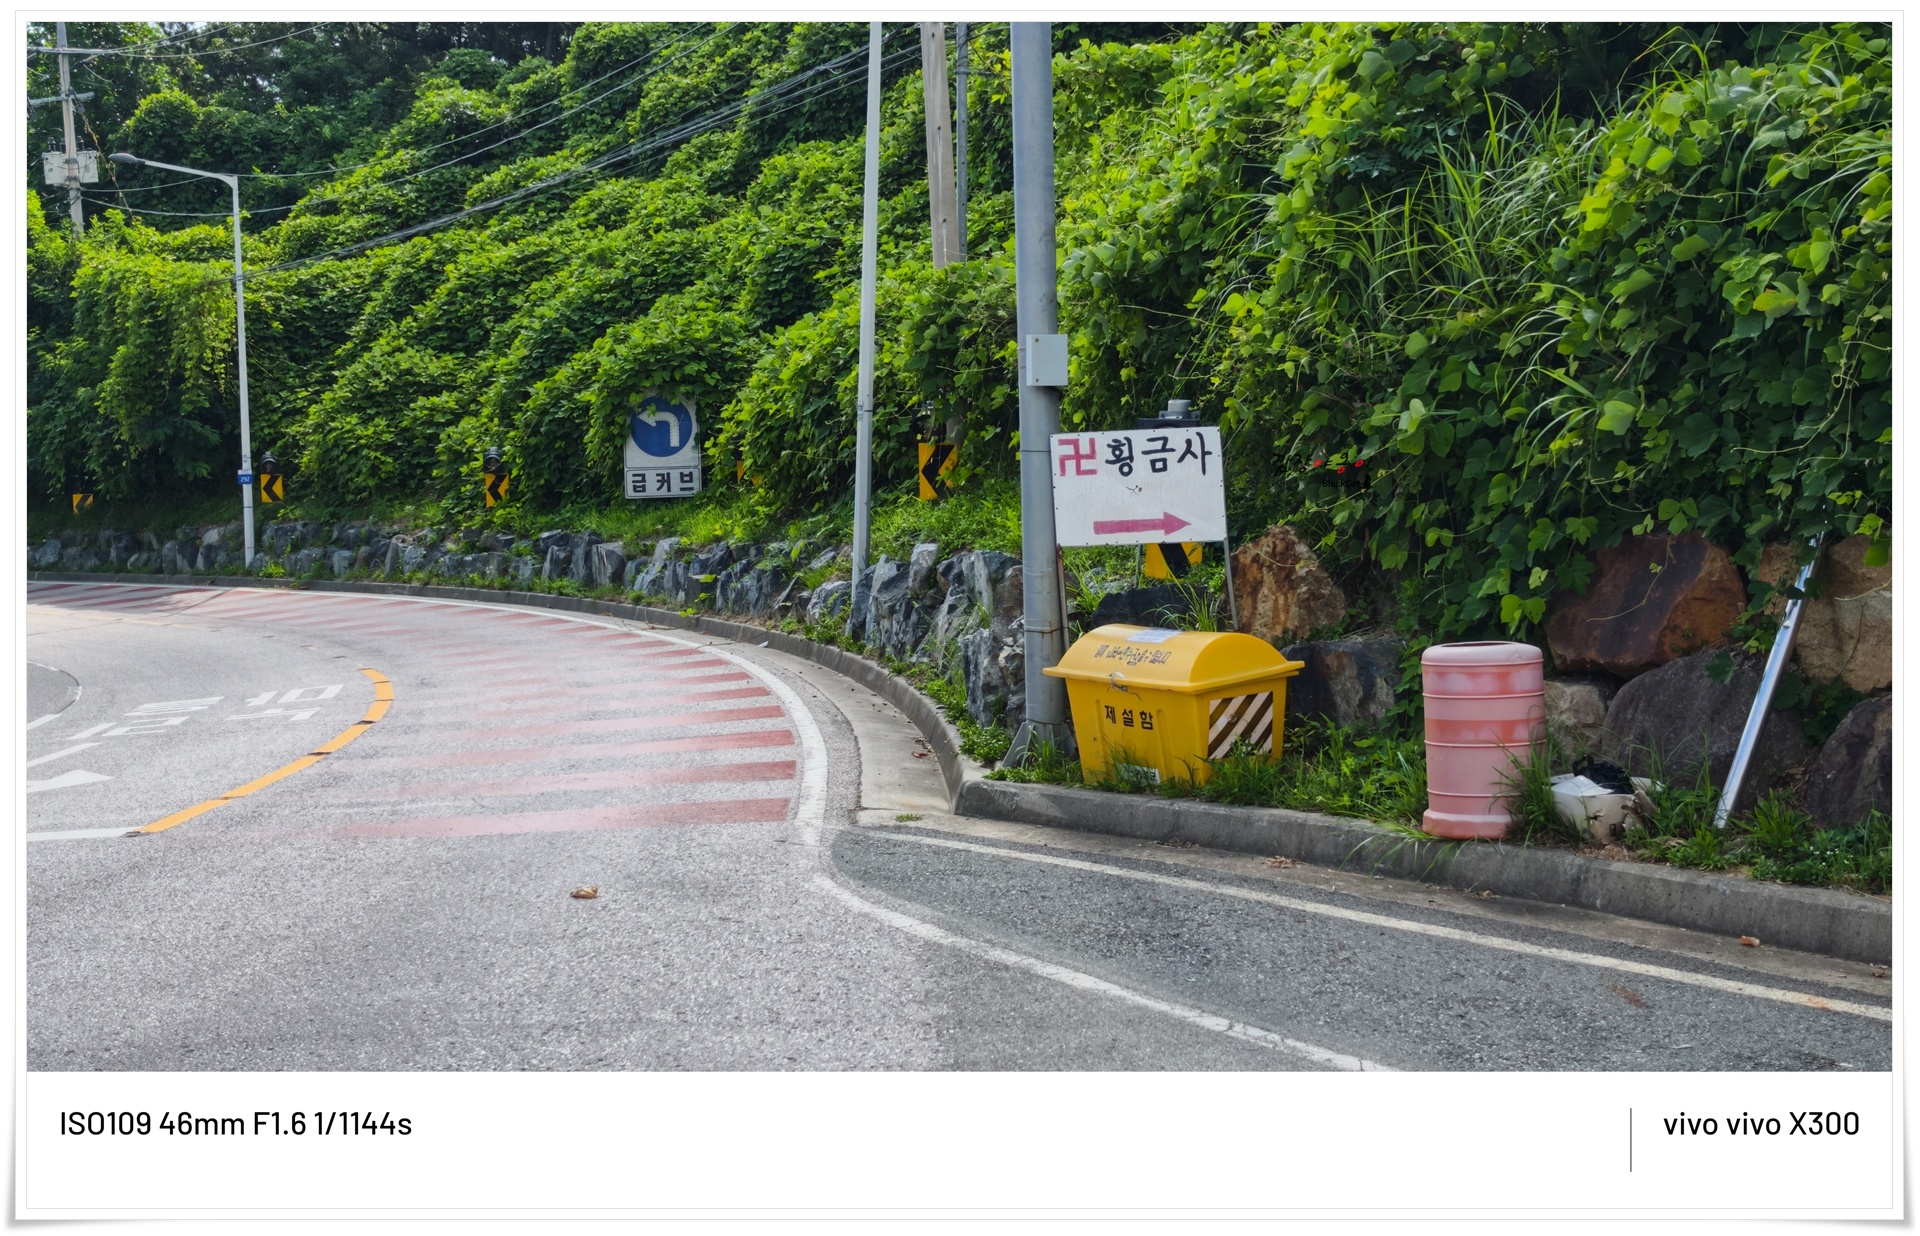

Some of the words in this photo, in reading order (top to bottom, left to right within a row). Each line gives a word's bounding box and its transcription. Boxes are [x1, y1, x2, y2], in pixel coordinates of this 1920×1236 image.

[1104, 431, 1213, 477] 황금사
[631, 471, 695, 493] 급커브
[1104, 704, 1154, 731] 제설함
